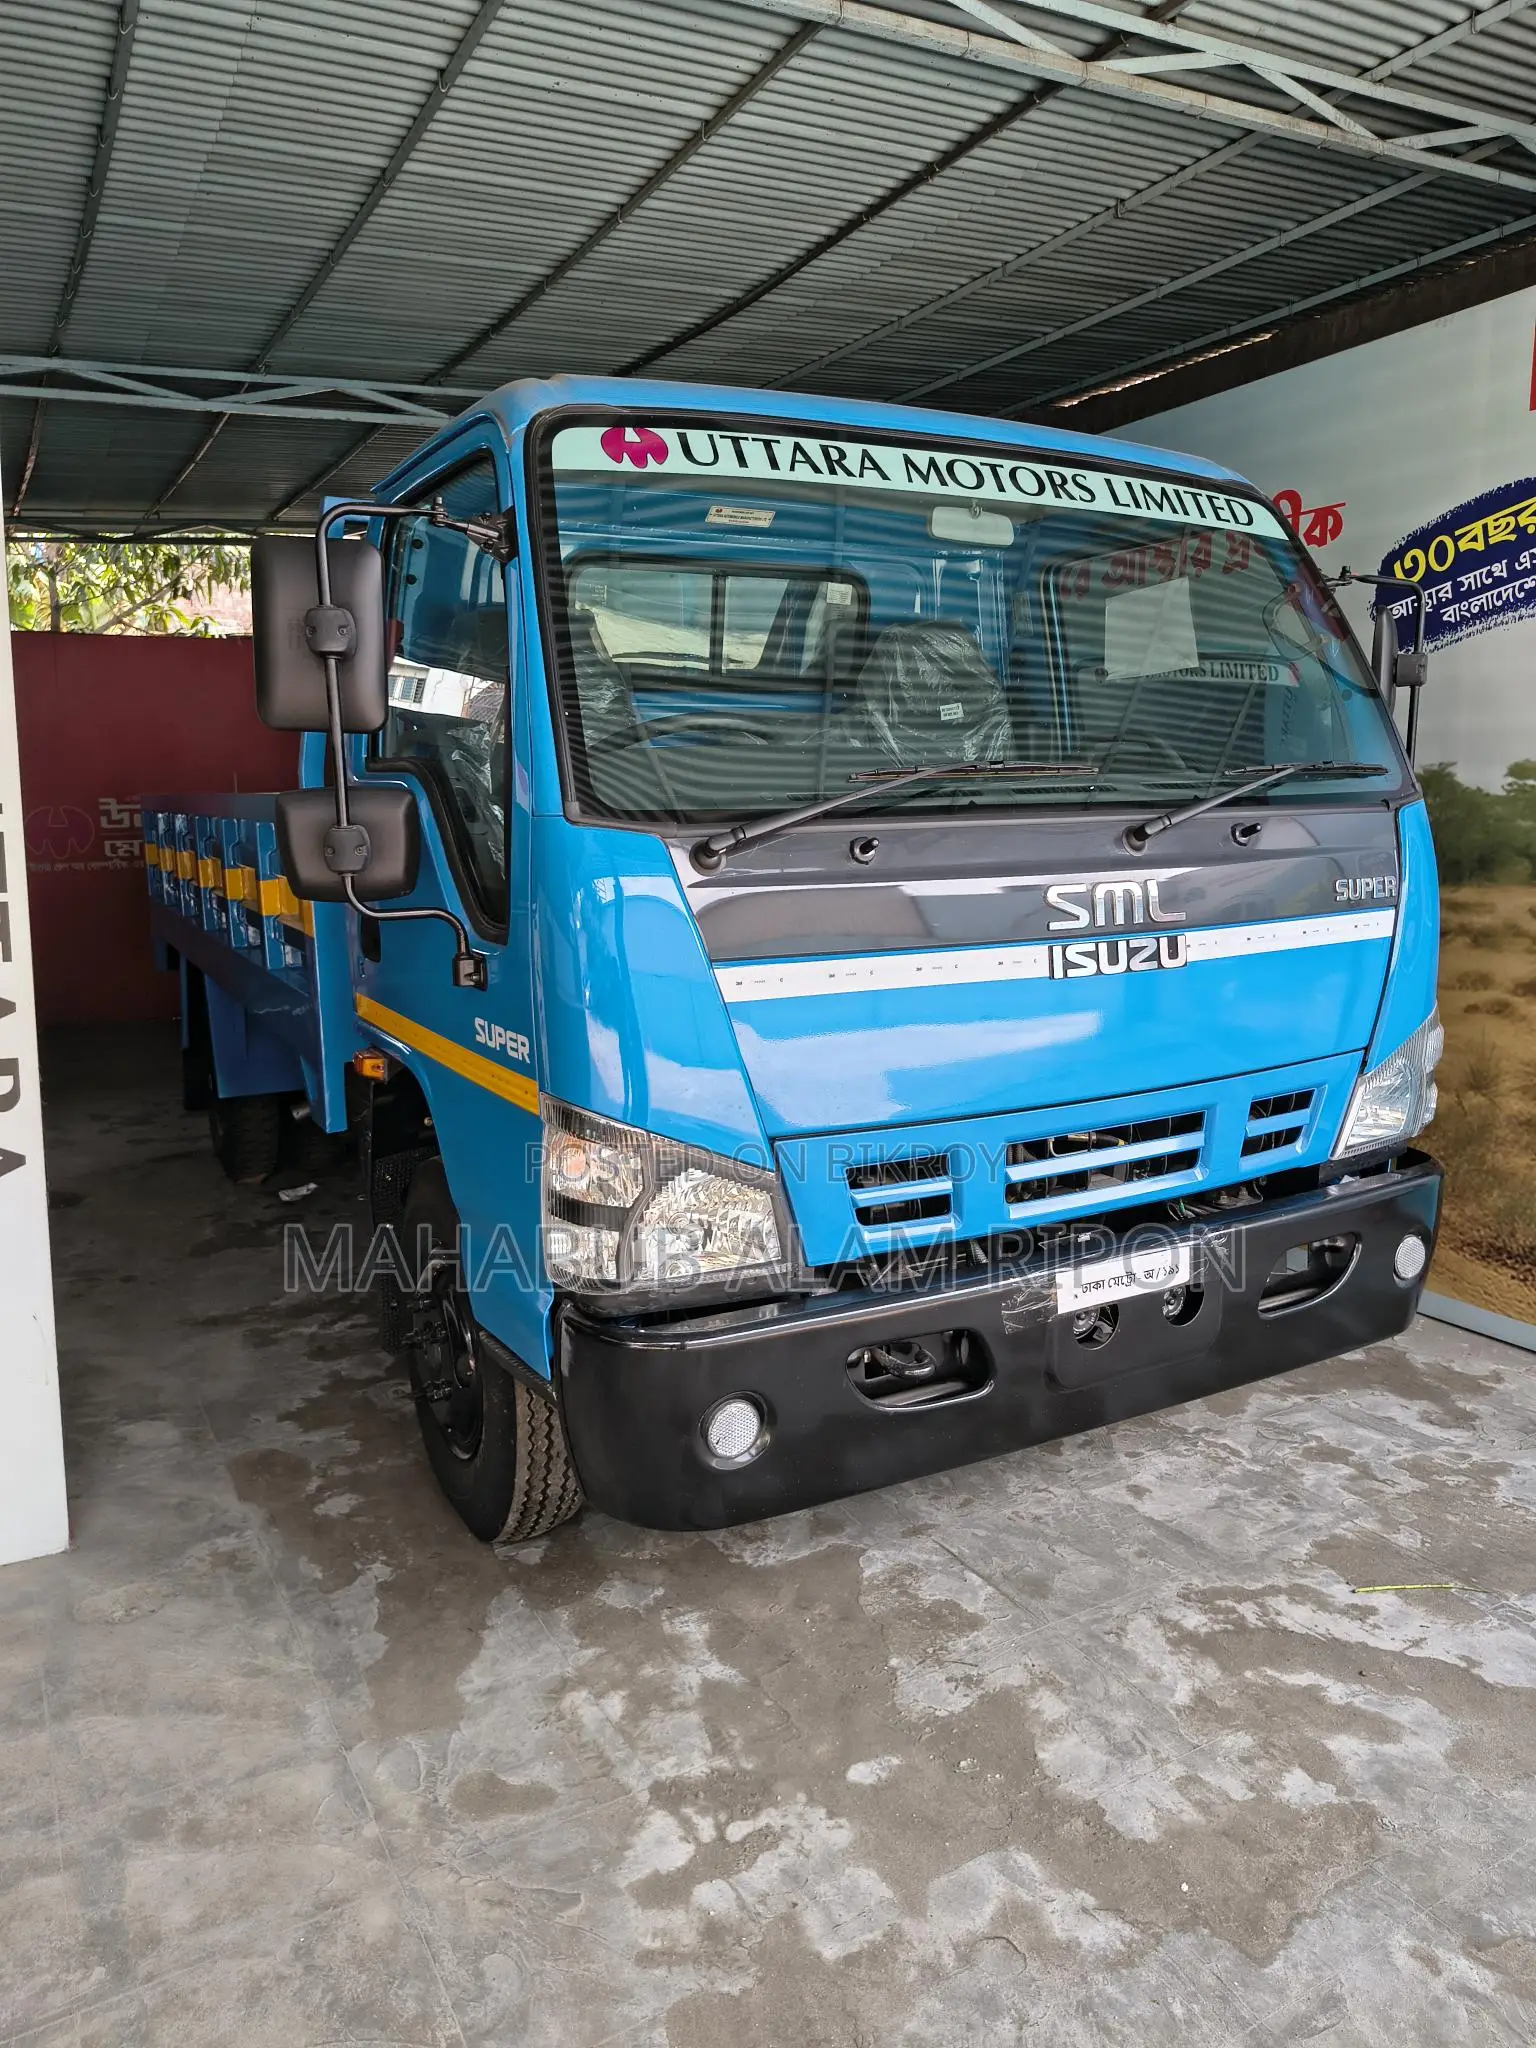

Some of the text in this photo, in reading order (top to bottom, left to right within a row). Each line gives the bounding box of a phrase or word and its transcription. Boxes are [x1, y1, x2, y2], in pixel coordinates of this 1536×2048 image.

[677, 431, 1254, 527] UTTARA MOTORS LIMITED
[1456, 560, 1508, 592] সাথে
[1046, 878, 1187, 931] SML
[1335, 875, 1397, 901] SUPER
[1048, 934, 1188, 979] ISUZU
[474, 1016, 531, 1064] SUPER
[1081, 1279, 1106, 1294] ঢাকা
